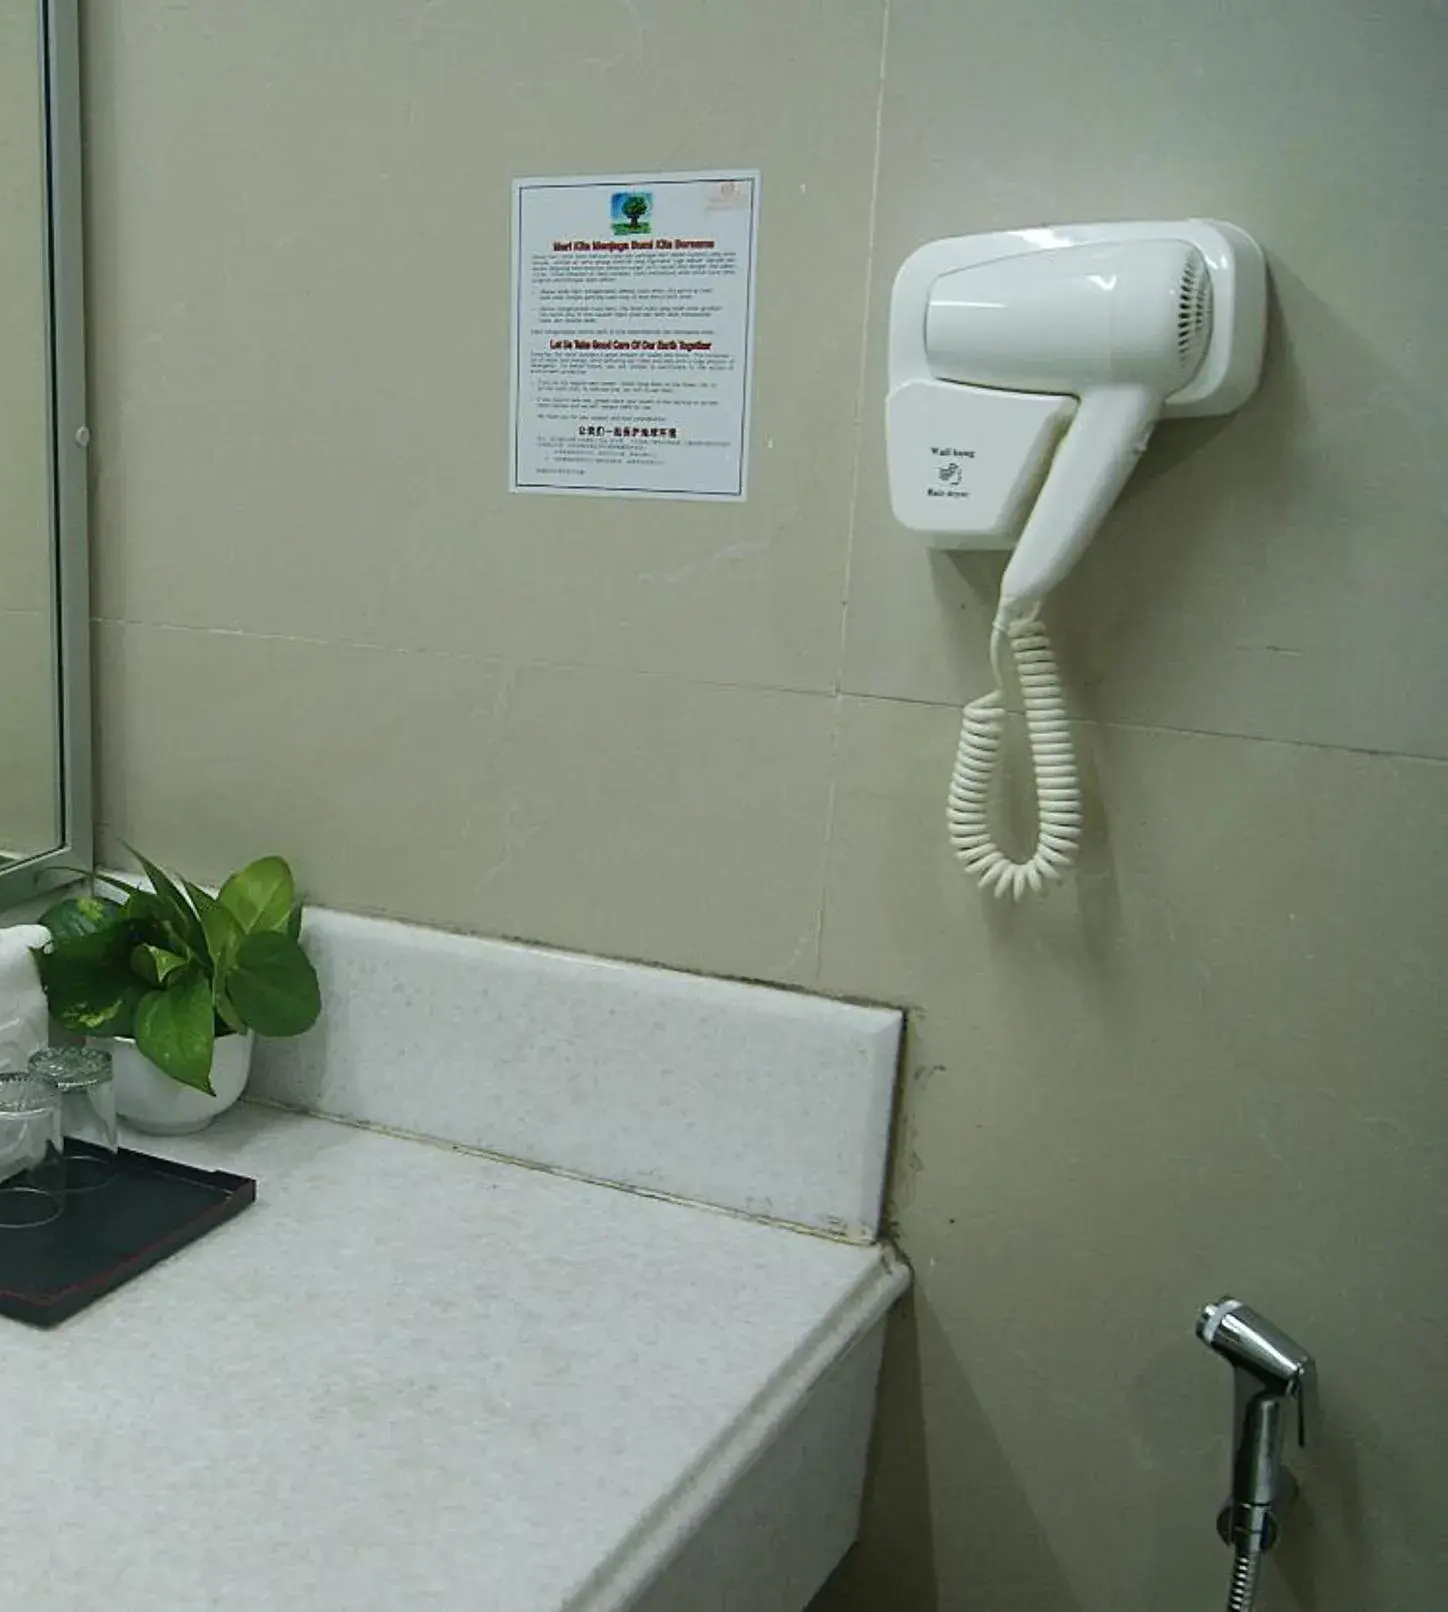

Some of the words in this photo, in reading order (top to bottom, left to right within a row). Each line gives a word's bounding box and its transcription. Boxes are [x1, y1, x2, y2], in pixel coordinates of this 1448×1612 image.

[574, 241, 590, 251] Kita
[592, 240, 629, 253] Menjaga
[656, 239, 672, 250] Kita
[549, 339, 563, 350] Let
[573, 340, 591, 350] Take
[592, 340, 612, 350] Good
[613, 340, 630, 350] Care
[631, 340, 642, 350] Of
[642, 340, 656, 350] Our
[656, 340, 678, 350] Earth
[678, 341, 713, 352] Together
[930, 446, 952, 456] Wall
[927, 488, 945, 497] Hair
[947, 489, 970, 499] dryer
